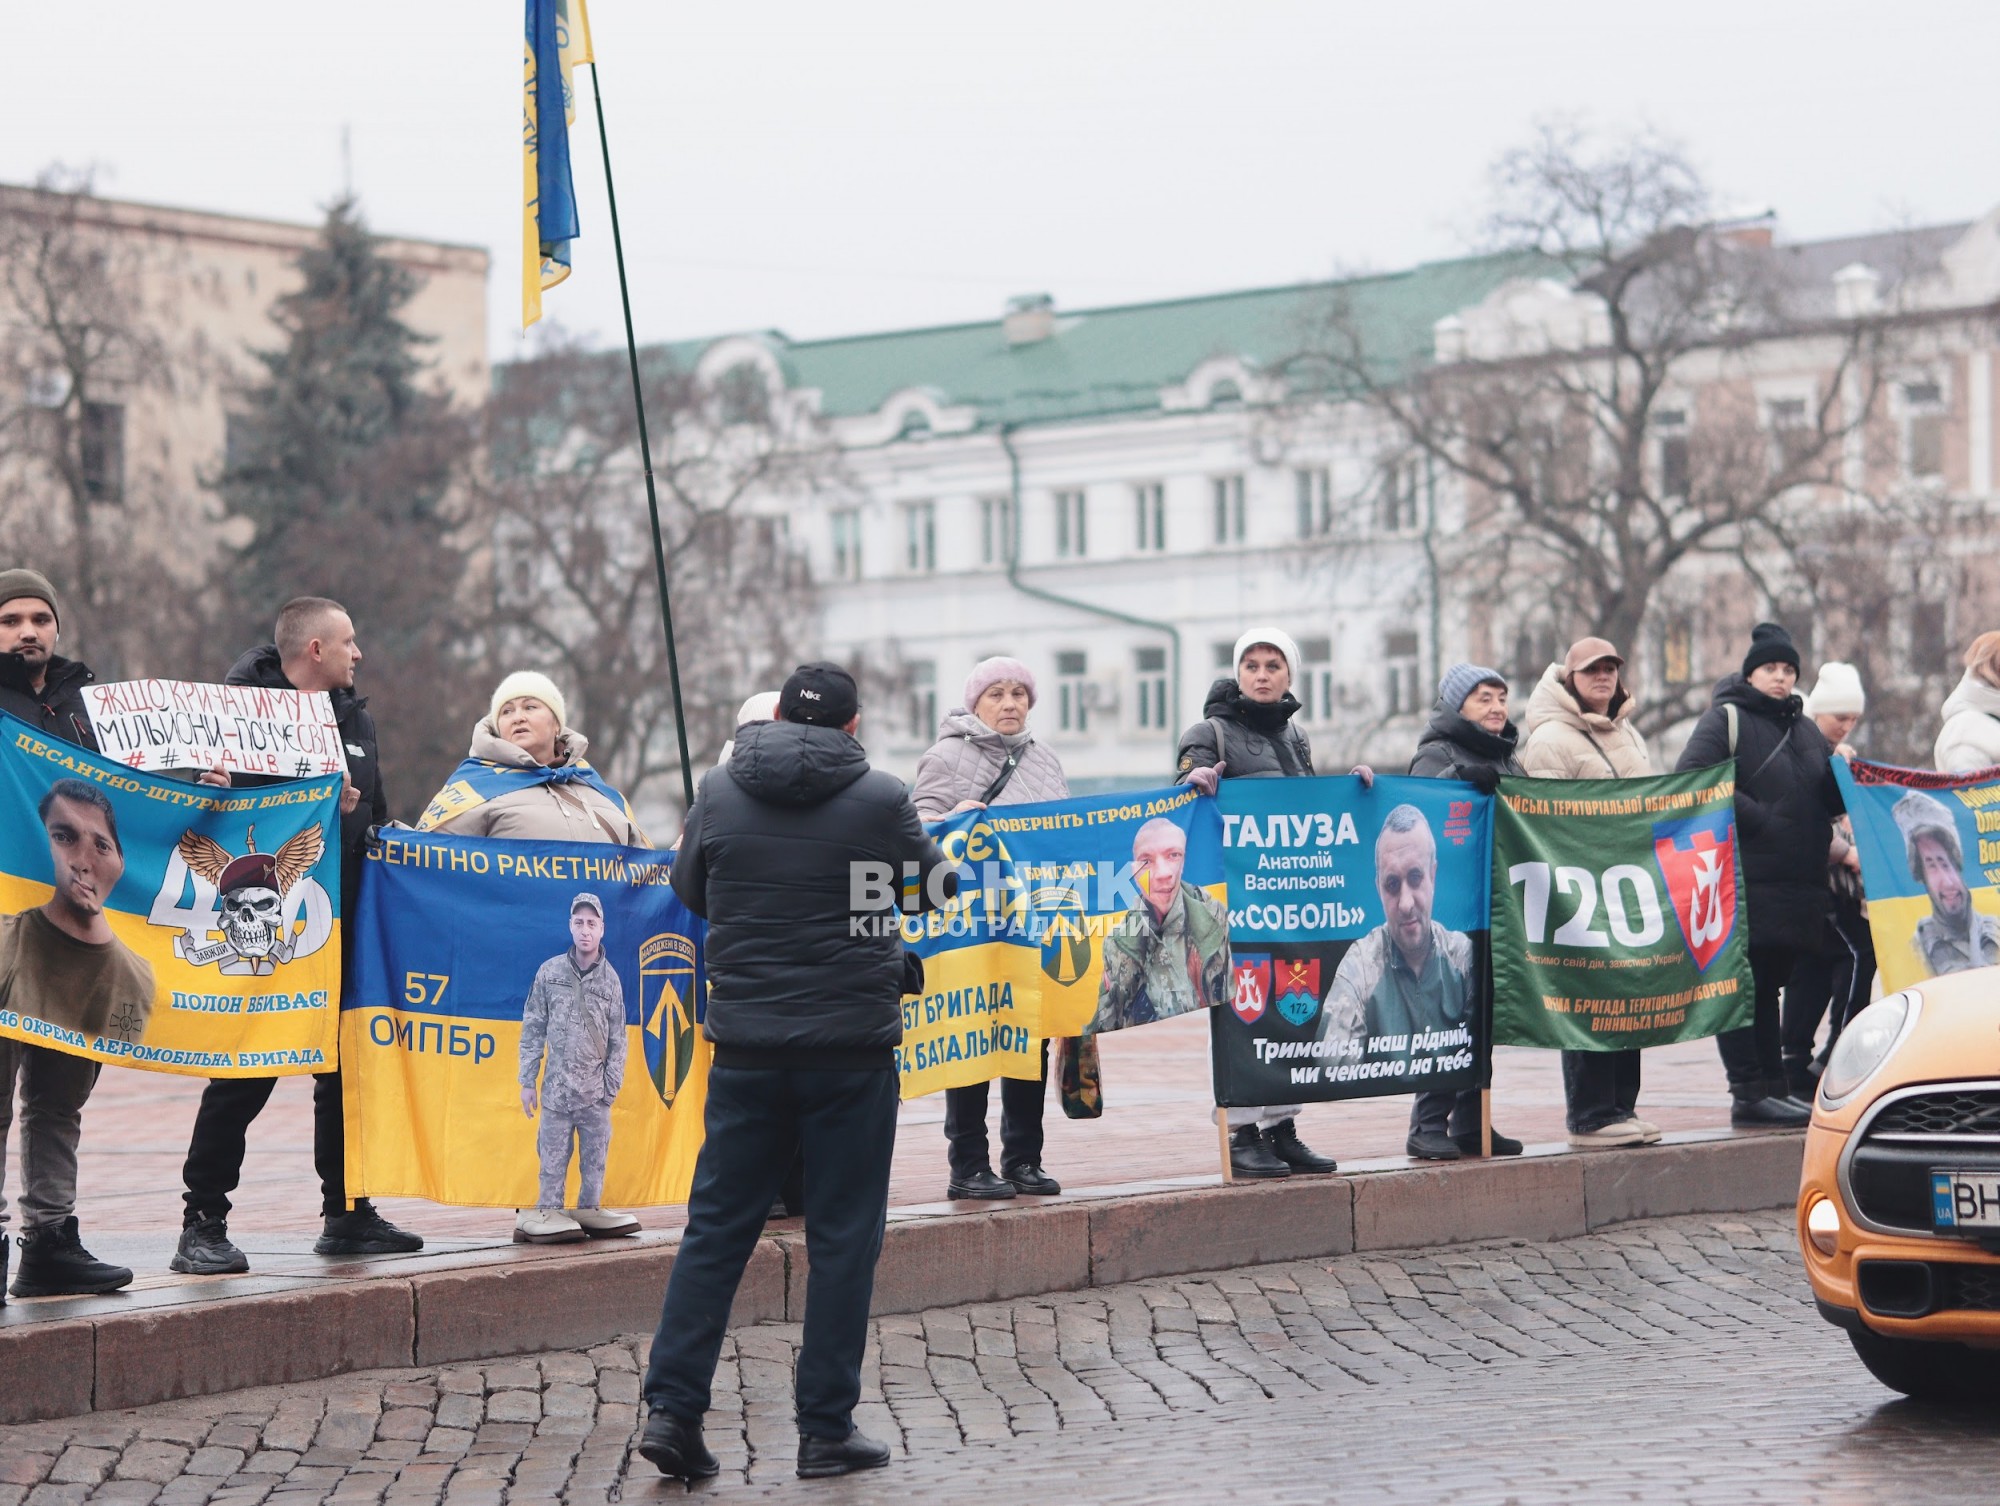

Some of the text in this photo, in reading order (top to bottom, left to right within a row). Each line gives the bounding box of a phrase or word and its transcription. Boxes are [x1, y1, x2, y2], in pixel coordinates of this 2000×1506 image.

[93, 679, 334, 723] ЯКЩО КРИЧАТИМУТЬ
[297, 721, 340, 758] СВІТ
[15, 733, 332, 812] ДЕСАНТНО-ШТУРМОВІ ВІЙСЬКА
[990, 789, 1200, 833] ПОВЕРНІТЬ ГЕРОЯ ДОДОМ
[1552, 795, 1642, 815] ТЕРИТОРІАЛЬНОЇ
[1644, 792, 1692, 812] ОБОРОНИ
[1695, 781, 1735, 805] УКРАЇН
[498, 855, 628, 883] РАКЕТНИЙ
[1024, 862, 1096, 881] БРИГАДА
[1257, 851, 1333, 870] Анатолій
[1245, 873, 1344, 891] Васильович
[1227, 903, 1365, 930] «СОБОЛЬ»
[1508, 861, 1664, 947] 120
[194, 944, 229, 963] ЗАВЖДИ
[642, 939, 674, 959] НАРОДЖЕНІ
[673, 940, 678, 951] В
[1563, 957, 1586, 968] свій
[1588, 957, 1607, 971] дім,
[1609, 957, 1651, 969] захистимо
[1652, 951, 1684, 966] Україну!
[171, 990, 328, 1014] ПОЛОН ВБИВАЄ!
[404, 971, 450, 1006] 57
[903, 982, 1013, 1030] 57 БРИГАДА
[1290, 1003, 1308, 1014] 172
[1574, 998, 1625, 1016] БРИГАДА
[1591, 1009, 1686, 1032] ВІННИЦЬКА ОБЛАСТЬ
[0, 1010, 324, 1068] 46 ОКРЕМА АЕРОМОБІЛЬНА БРИГАДА
[370, 1014, 496, 1064] ОМПБр
[915, 1019, 1029, 1071] БАТАЛЬЙОН
[1253, 1022, 1473, 1064] Тримайся, наш рідний,
[1290, 1050, 1473, 1084] ми чекаємо на тебе
[1937, 1207, 1952, 1219] UA
[1954, 1183, 2000, 1220] BH
